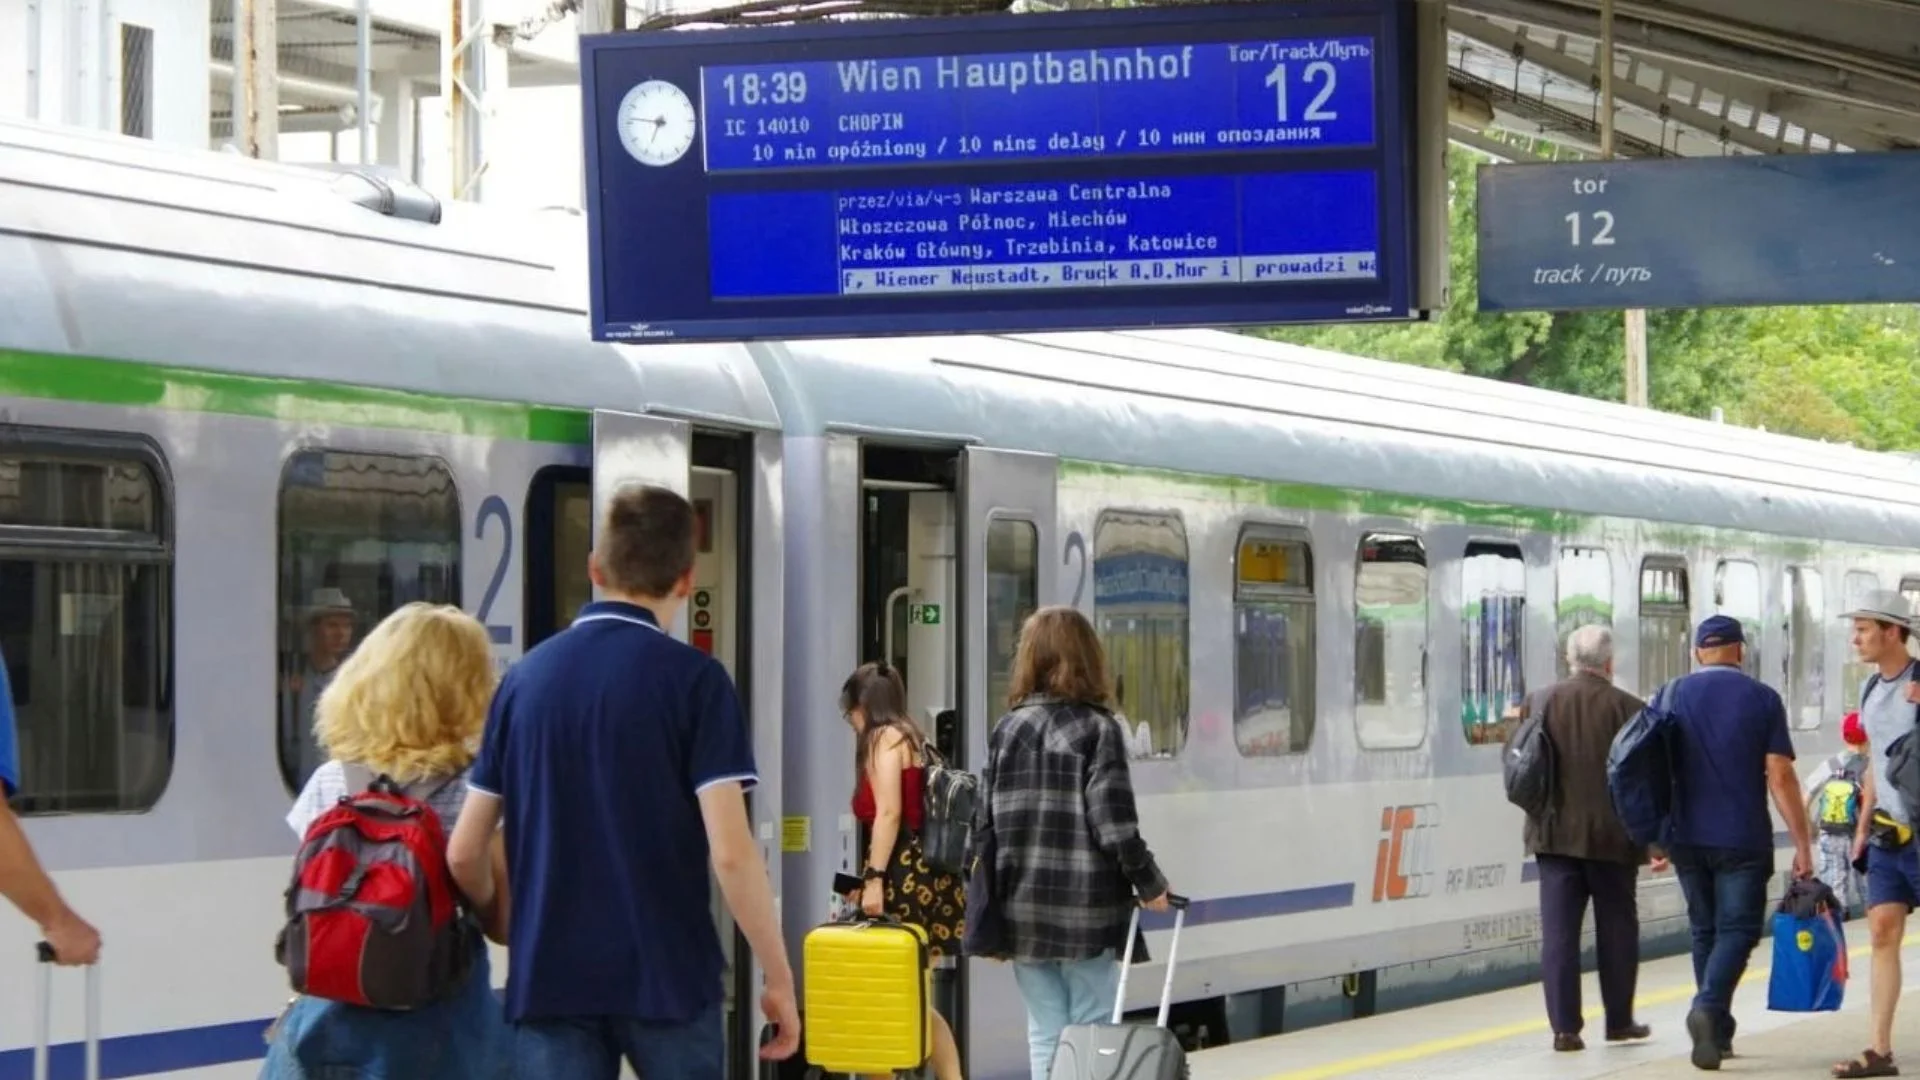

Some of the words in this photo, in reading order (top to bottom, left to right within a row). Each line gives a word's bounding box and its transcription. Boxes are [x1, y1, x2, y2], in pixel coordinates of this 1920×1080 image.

[1228, 41, 1371, 62] Tor/Track/Путь
[837, 59, 921, 93] Wien
[937, 46, 1194, 94] Hauptbahnhof
[723, 71, 807, 106] 18:39
[1265, 61, 1337, 122] 12
[724, 119, 746, 136] IC
[757, 116, 810, 136] 14010
[838, 113, 904, 132] CHOPIN
[752, 144, 774, 161] 10
[784, 142, 816, 160] min
[828, 139, 927, 161] opóźniony
[937, 137, 948, 155] /
[958, 136, 982, 153] 10
[993, 134, 1037, 152] mins
[1048, 131, 1105, 151] delay
[1116, 129, 1127, 147] /
[1138, 128, 1161, 146] 10
[1217, 126, 1322, 143] опоздания
[970, 187, 1058, 205] Warszawa
[1069, 181, 1172, 201] Centralna
[1573, 177, 1608, 194] tor
[839, 217, 948, 235] Włoszczowa
[959, 212, 1036, 231] Północ,
[1048, 208, 1128, 228] Miechów
[1565, 210, 1616, 246] 12
[841, 242, 906, 261] Kraków
[916, 240, 993, 260] Główny,
[1006, 236, 1116, 256] Trzebinia,
[1128, 233, 1218, 252] Katowice
[875, 270, 939, 287] Wiener
[951, 266, 1050, 285] Neustadt,
[1062, 264, 1119, 281] Bruck
[1221, 260, 1230, 277] i
[1255, 256, 1346, 278] prowadzi
[1533, 263, 1584, 284] track
[1590, 263, 1605, 283] /
[1605, 266, 1652, 286] путь
[475, 494, 513, 644] 2
